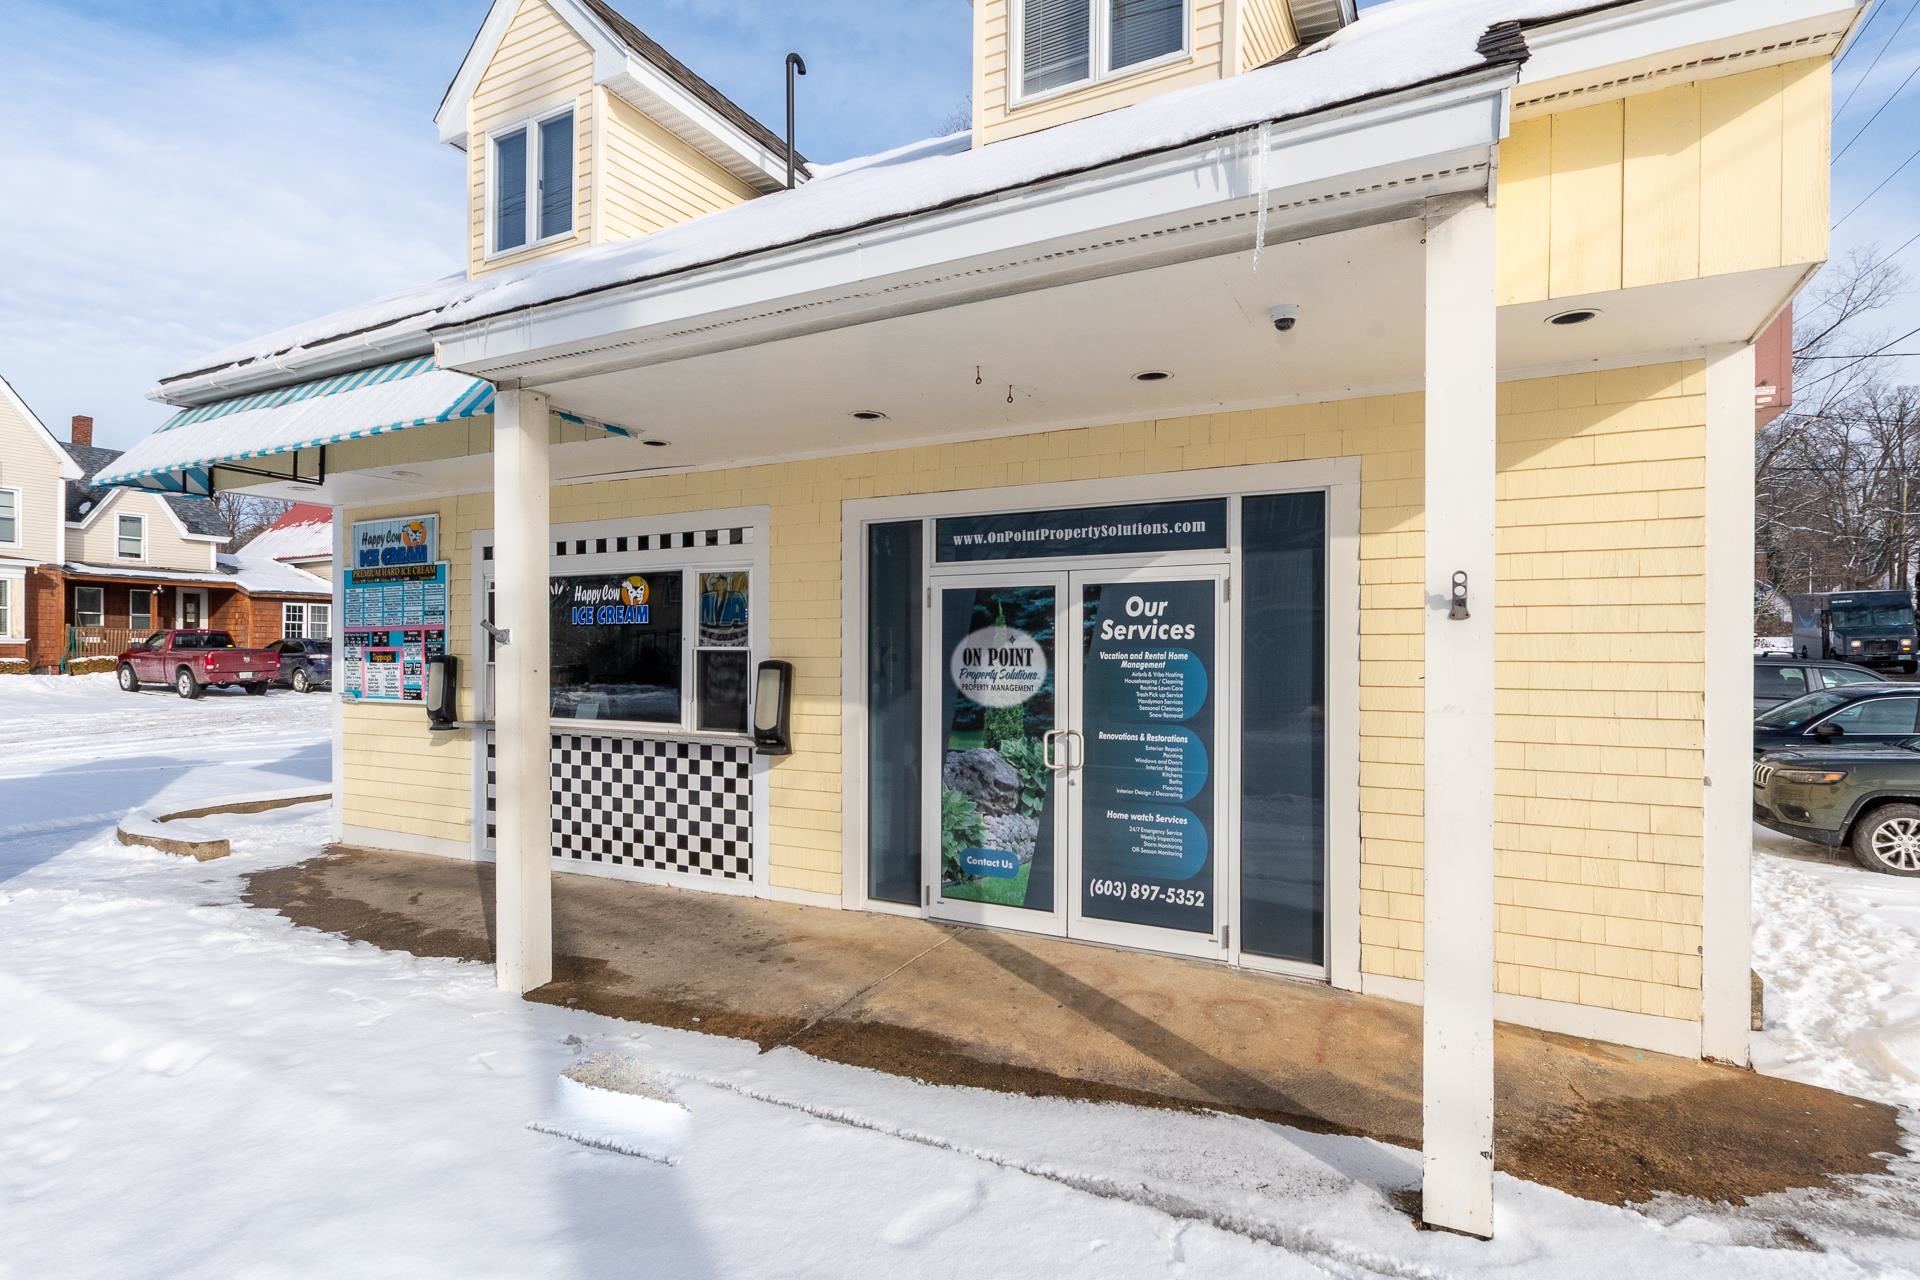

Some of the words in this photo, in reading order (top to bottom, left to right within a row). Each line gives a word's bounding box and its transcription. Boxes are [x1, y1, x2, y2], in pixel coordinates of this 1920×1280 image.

[362, 532, 385, 547] Happy
[386, 530, 402, 544] Cow
[953, 520, 1206, 546] www.OnPointPropertySolutions.com
[360, 548, 380, 567] ICE
[381, 545, 428, 566] CREAM
[353, 569, 381, 578] PREMIUM
[383, 568, 400, 576] HARD
[401, 567, 412, 575] ICE
[412, 566, 436, 575] CREAM
[574, 585, 602, 604] Happy
[602, 583, 621, 601] Cow
[1126, 596, 1168, 617] Our
[571, 606, 594, 626] ICE
[597, 604, 649, 625] CREAM
[1100, 619, 1196, 640] Services
[963, 648, 982, 666] ON
[988, 648, 1034, 667] POINT
[1100, 651, 1128, 660] Vacation
[1130, 652, 1143, 660] and
[1145, 652, 1167, 660] Rental
[1168, 652, 1189, 660] Home
[1121, 660, 1166, 670] Management
[959, 668, 998, 683] Property
[999, 668, 1038, 681] Solutions
[991, 684, 1034, 692] MANAGEMENT
[1099, 731, 1139, 741] Renovations
[1140, 733, 1145, 742] &
[1146, 733, 1189, 744] Restorations
[1156, 791, 1183, 799] Decorating
[1107, 810, 1129, 820] Home
[1130, 813, 1154, 822] watch
[1156, 814, 1188, 825] Services
[1140, 834, 1156, 842] Weekly
[1141, 827, 1165, 836] Emergency
[1158, 842, 1183, 851] Monitoring
[1158, 850, 1183, 858] Monitoring
[967, 856, 1000, 867] Contact
[1001, 860, 1014, 869] Us
[1090, 878, 1127, 901] (603)
[1130, 884, 1205, 907] 897-5352
